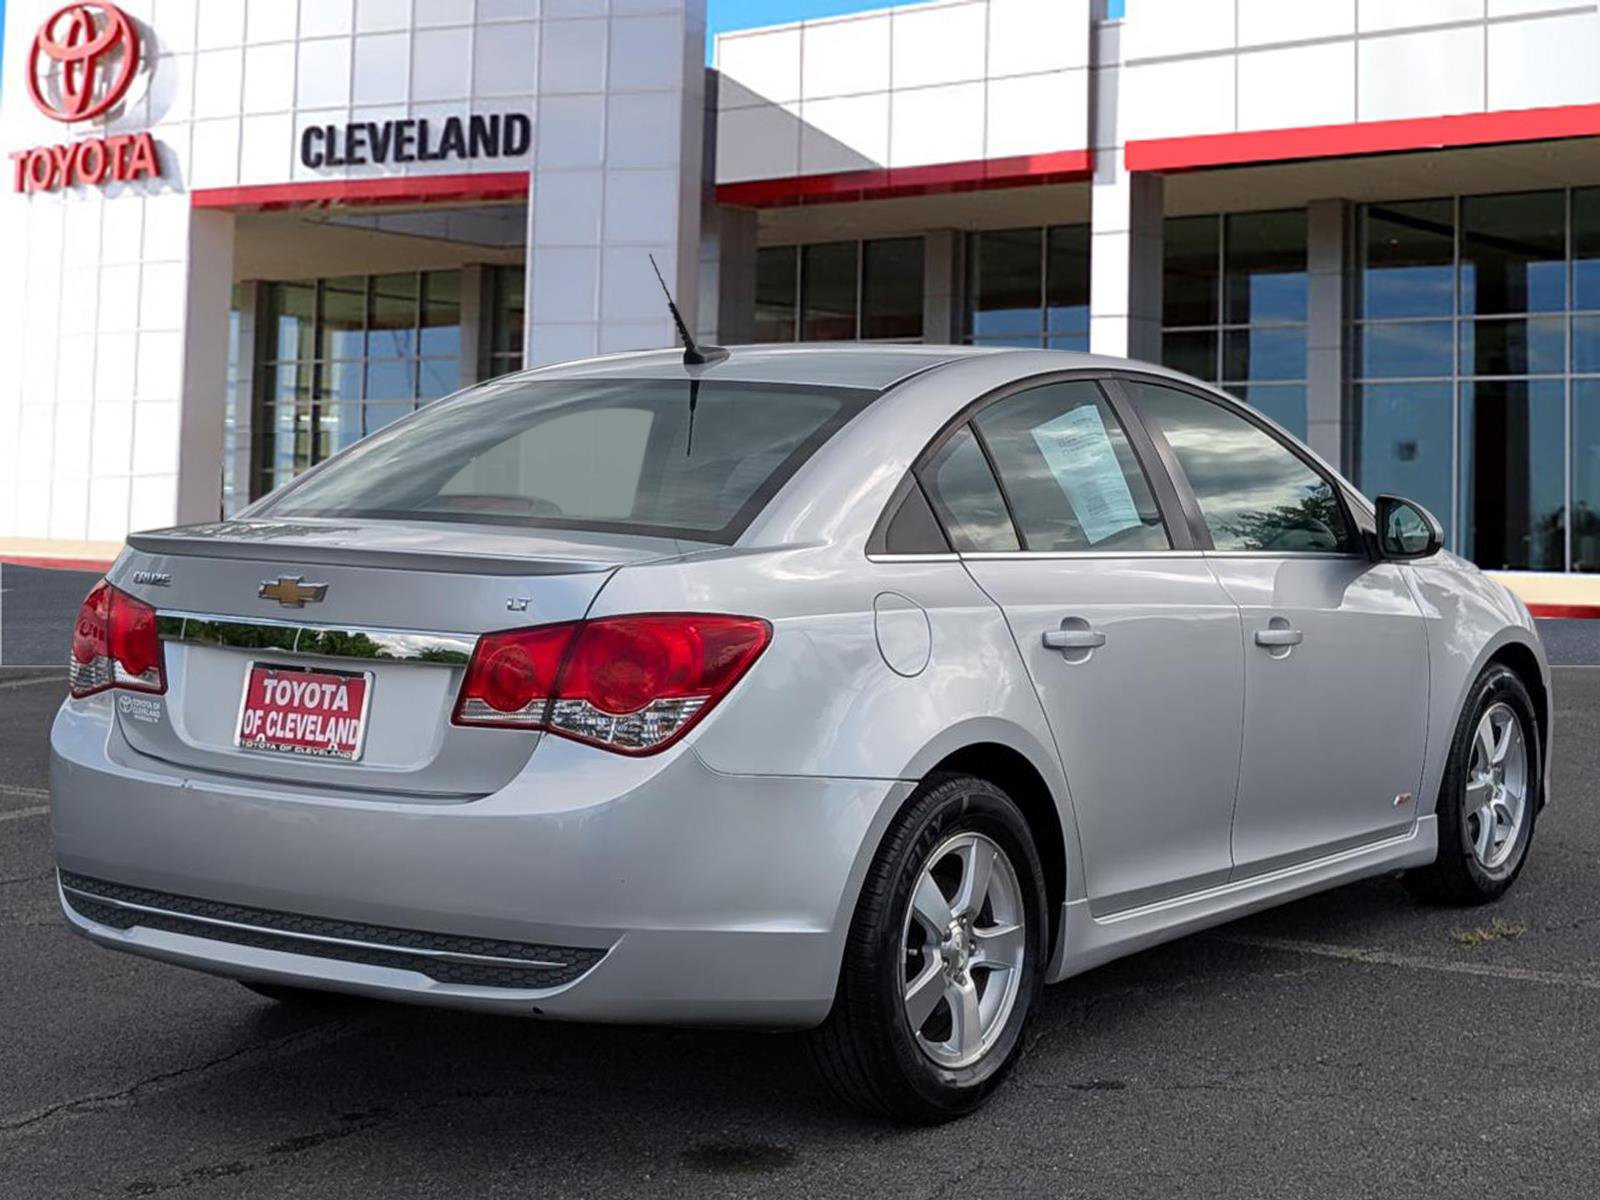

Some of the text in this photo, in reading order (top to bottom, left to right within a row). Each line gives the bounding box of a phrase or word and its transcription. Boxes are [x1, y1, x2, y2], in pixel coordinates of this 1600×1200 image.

[300, 113, 531, 170] CLEVELAND
[9, 131, 161, 193] TOYOTA
[263, 678, 349, 712] TOYOTA
[243, 708, 360, 744] OF CLEVELAND
[242, 740, 353, 759] TOYOTA OF CLEVELAND
